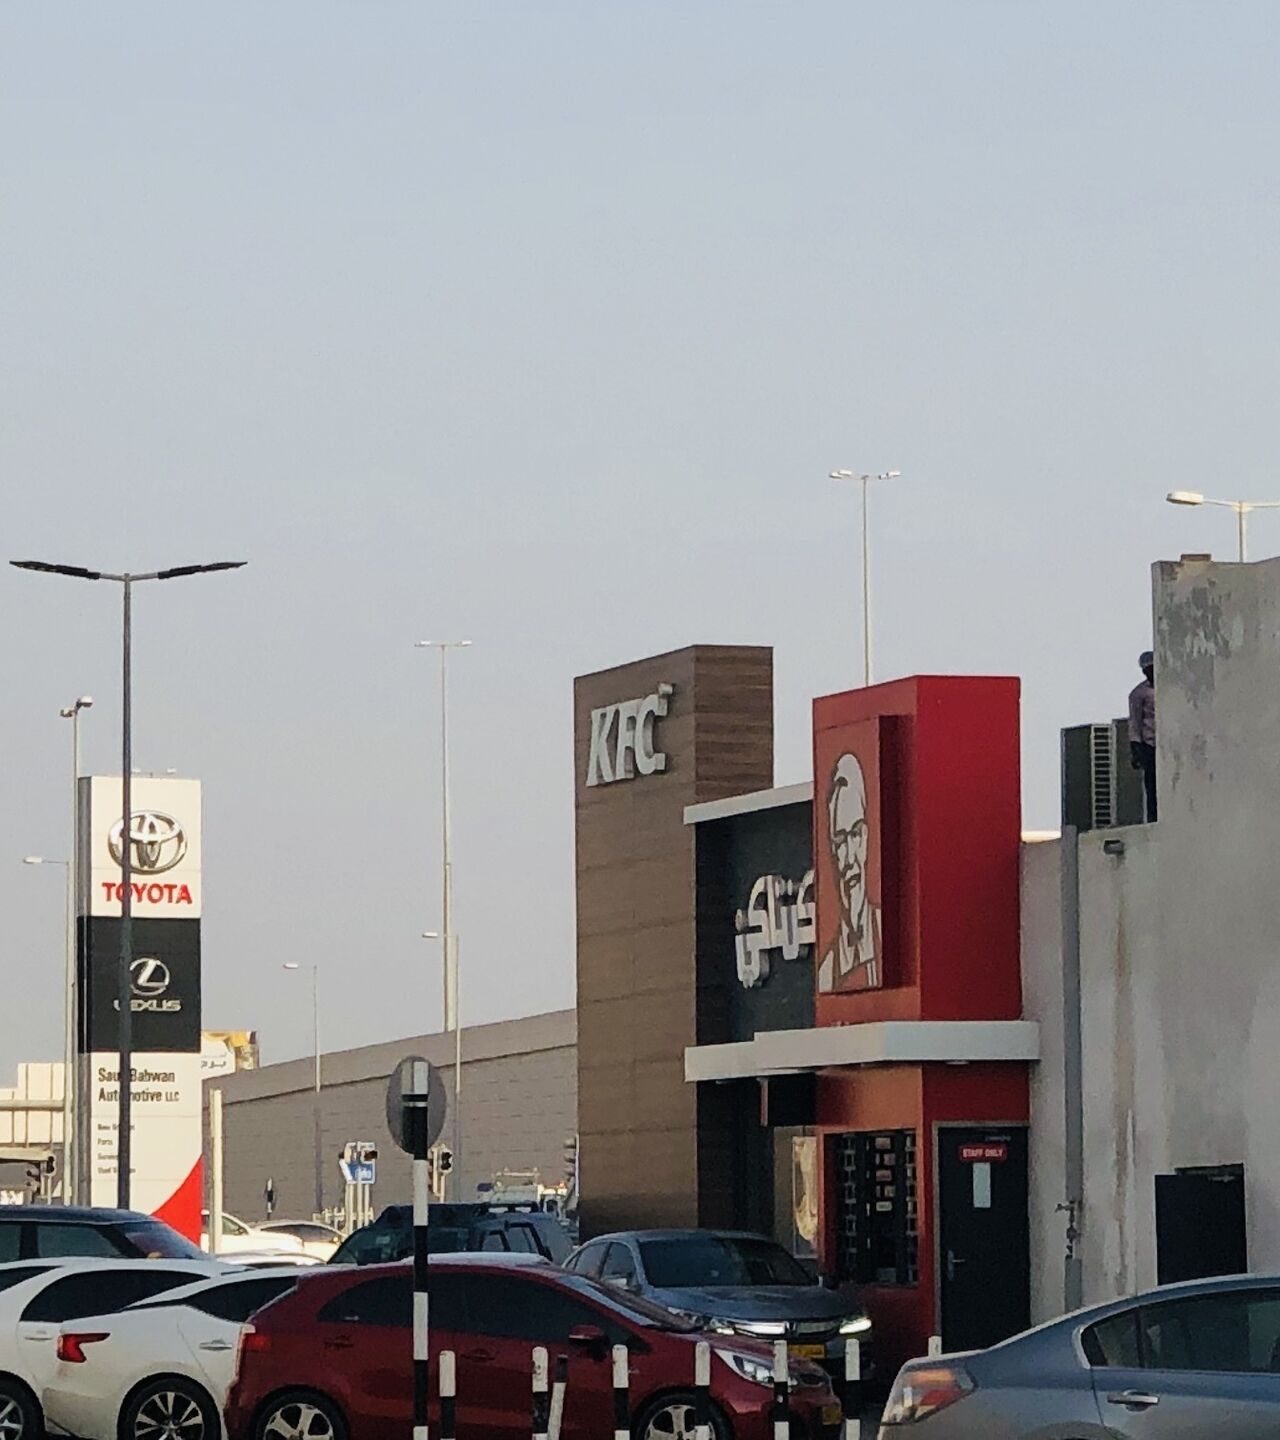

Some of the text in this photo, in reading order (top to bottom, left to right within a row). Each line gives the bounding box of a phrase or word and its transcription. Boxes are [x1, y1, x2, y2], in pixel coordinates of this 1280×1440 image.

[586, 689, 669, 787] KFC
[98, 1068, 122, 1082] Sau
[98, 1088, 162, 1102] Autmotive
